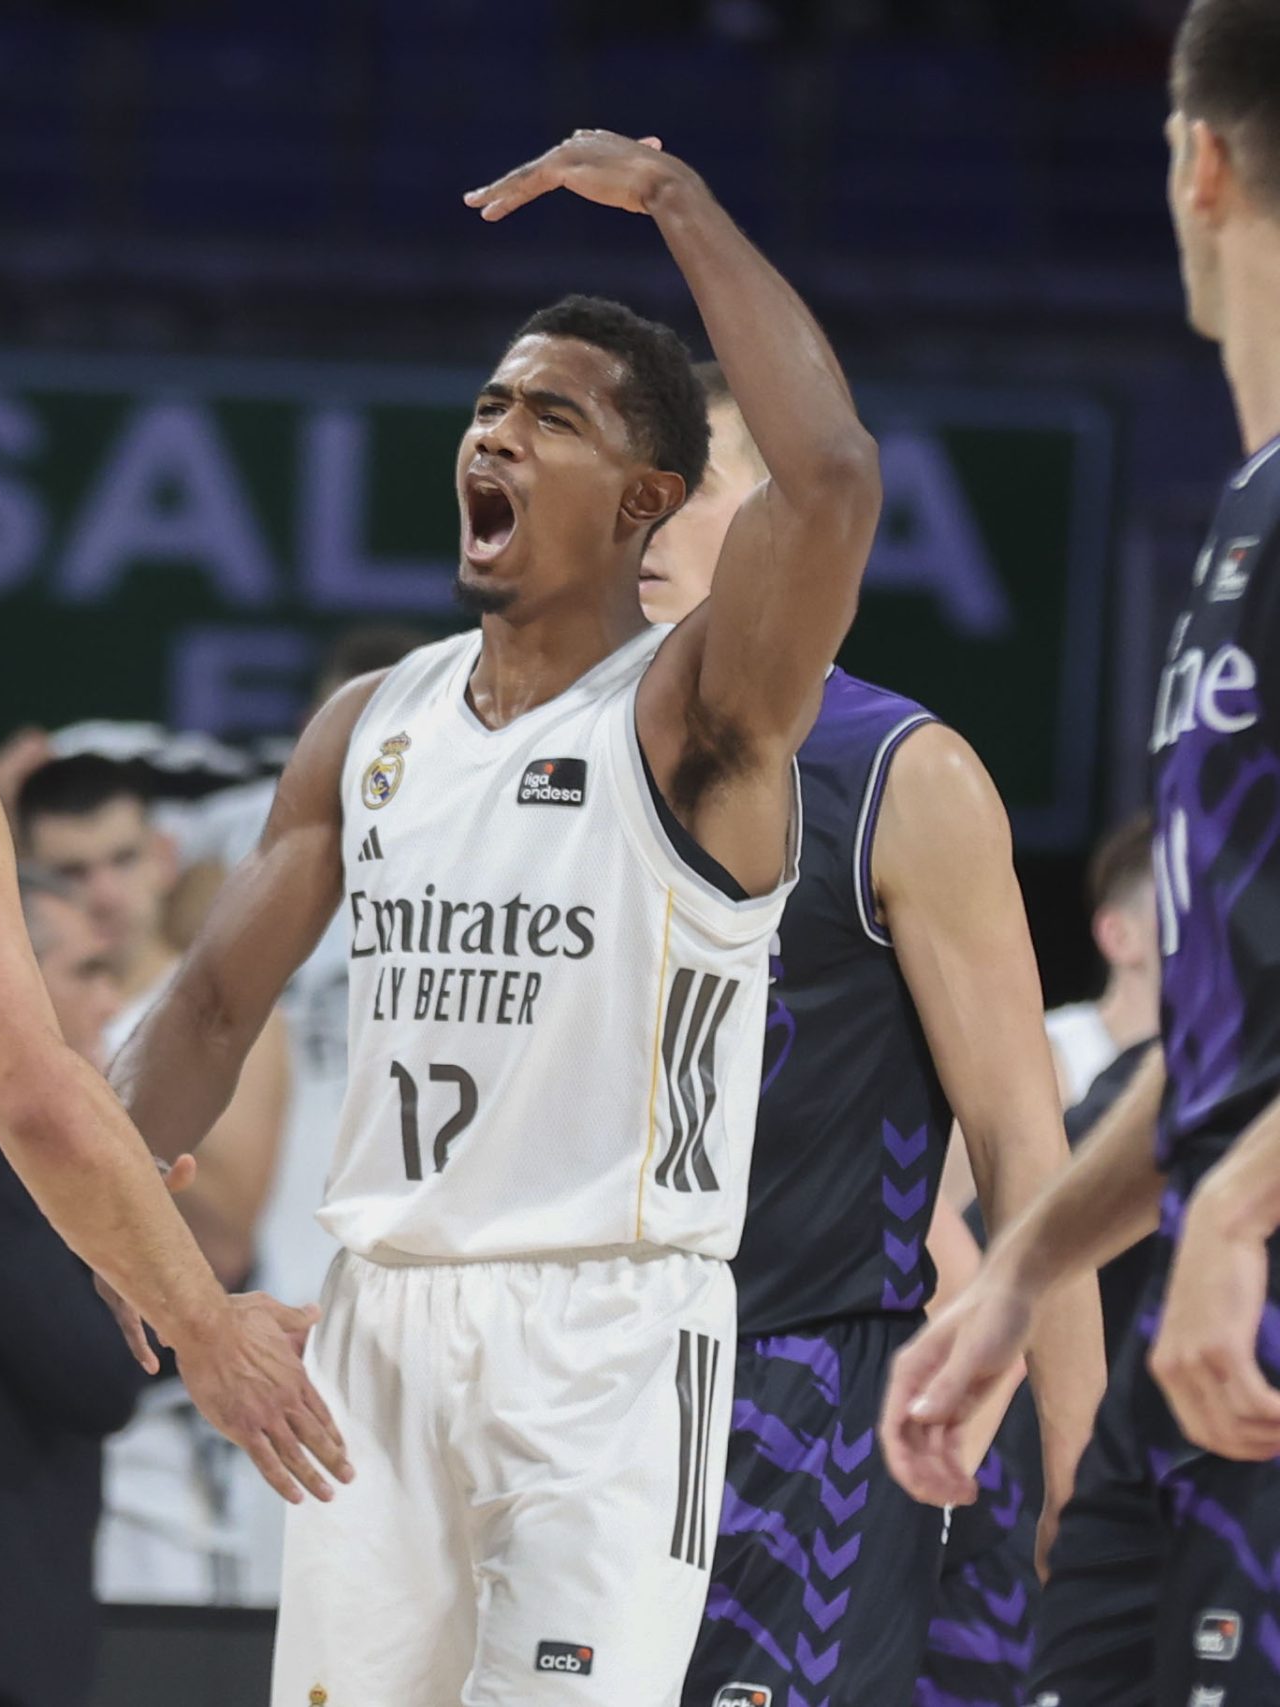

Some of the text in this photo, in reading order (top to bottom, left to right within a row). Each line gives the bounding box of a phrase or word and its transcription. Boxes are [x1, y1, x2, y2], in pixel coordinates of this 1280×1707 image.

[521, 785, 582, 802] endesa
[524, 772, 550, 788] liga
[350, 883, 595, 960] Emirates
[373, 966, 406, 1021] LY
[414, 967, 542, 1025] BETTER
[390, 1060, 479, 1181] 12
[540, 1654, 581, 1672] acb
